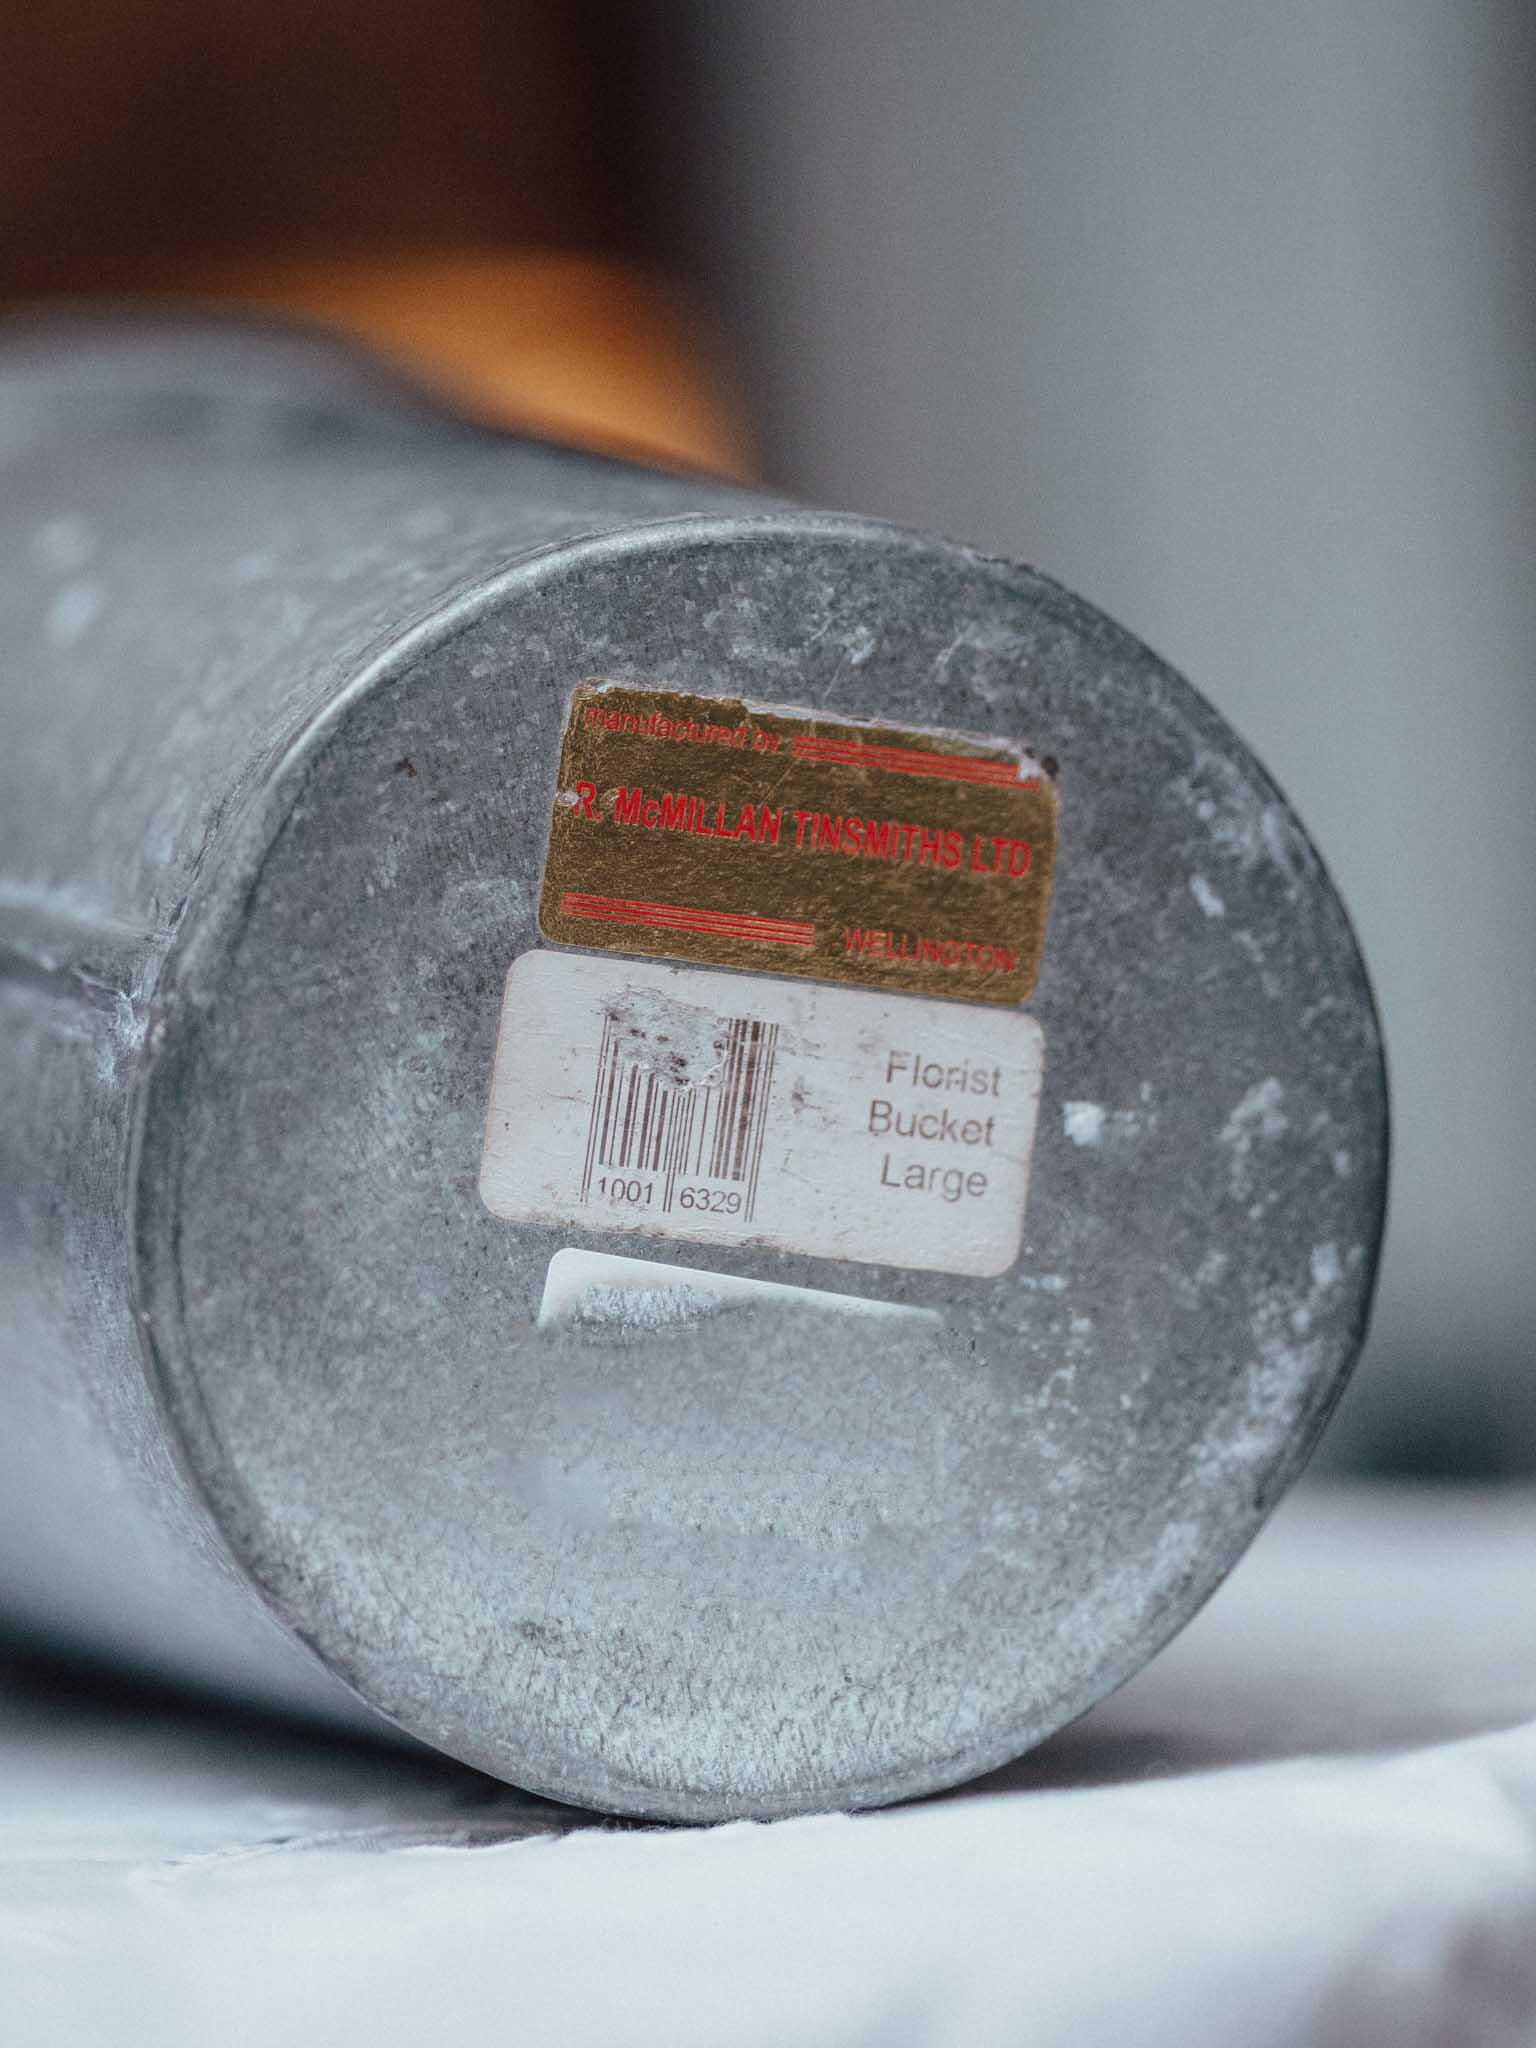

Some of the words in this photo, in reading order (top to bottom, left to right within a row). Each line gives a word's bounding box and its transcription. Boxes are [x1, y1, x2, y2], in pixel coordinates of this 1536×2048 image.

[584, 708, 746, 747] manufactured
[754, 724, 781, 754] by
[614, 786, 782, 845] McMILLAN
[792, 809, 963, 869] TINSMITHS
[971, 836, 1032, 878] LTD
[844, 928, 1016, 973] WELLINGTON
[886, 1050, 1001, 1097] Florist
[868, 1099, 994, 1146] Bucket
[597, 1176, 654, 1204] 1001
[680, 1187, 742, 1214] 6329
[880, 1153, 988, 1201] Large
